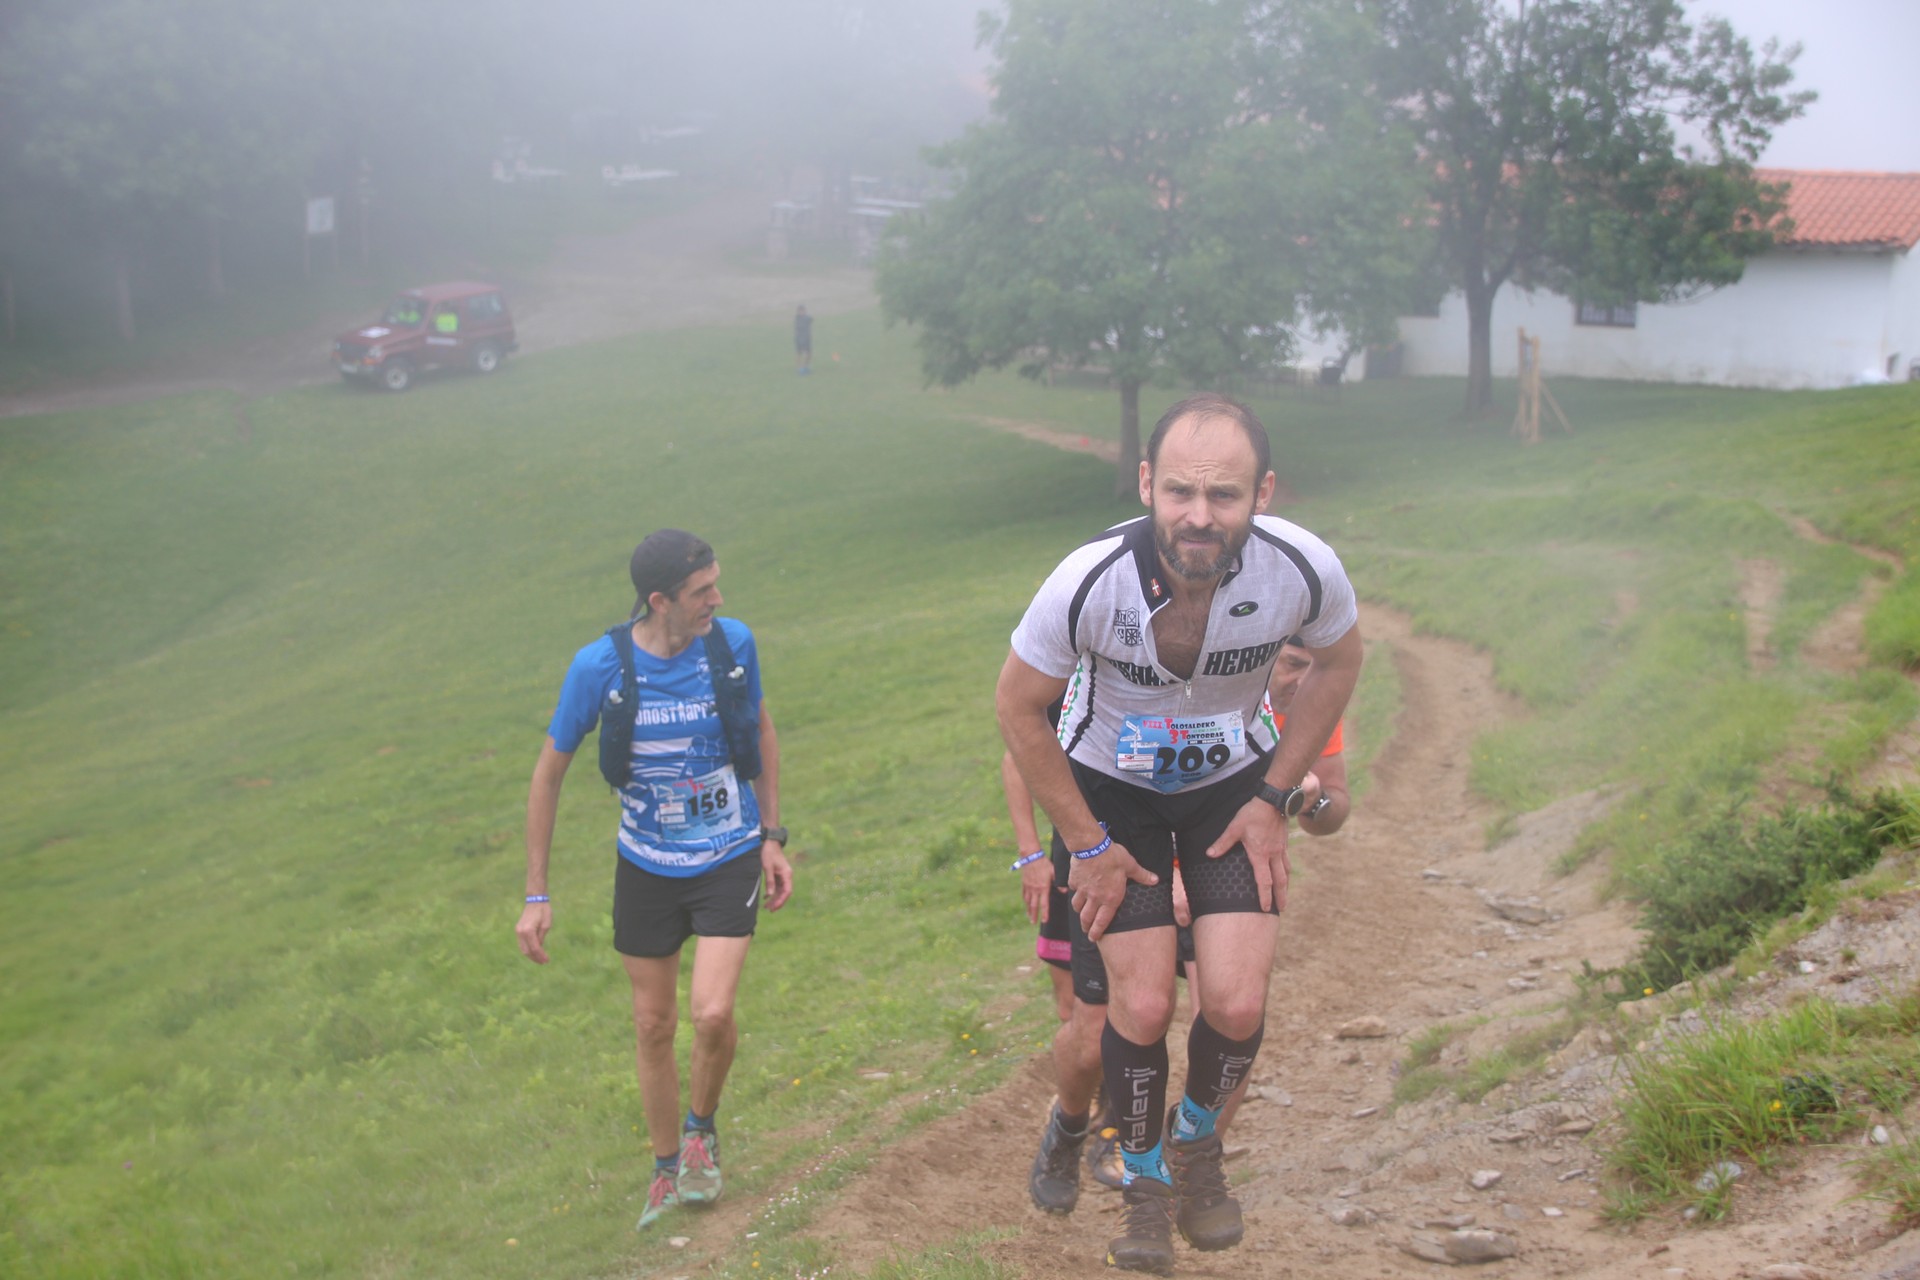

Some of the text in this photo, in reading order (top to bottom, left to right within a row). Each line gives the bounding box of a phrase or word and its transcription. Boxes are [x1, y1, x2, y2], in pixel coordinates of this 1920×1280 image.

[1169, 729, 1179, 745] 3
[1156, 744, 1230, 775] 209
[687, 787, 728, 817] 158
[1122, 1067, 1157, 1151] kalenji
